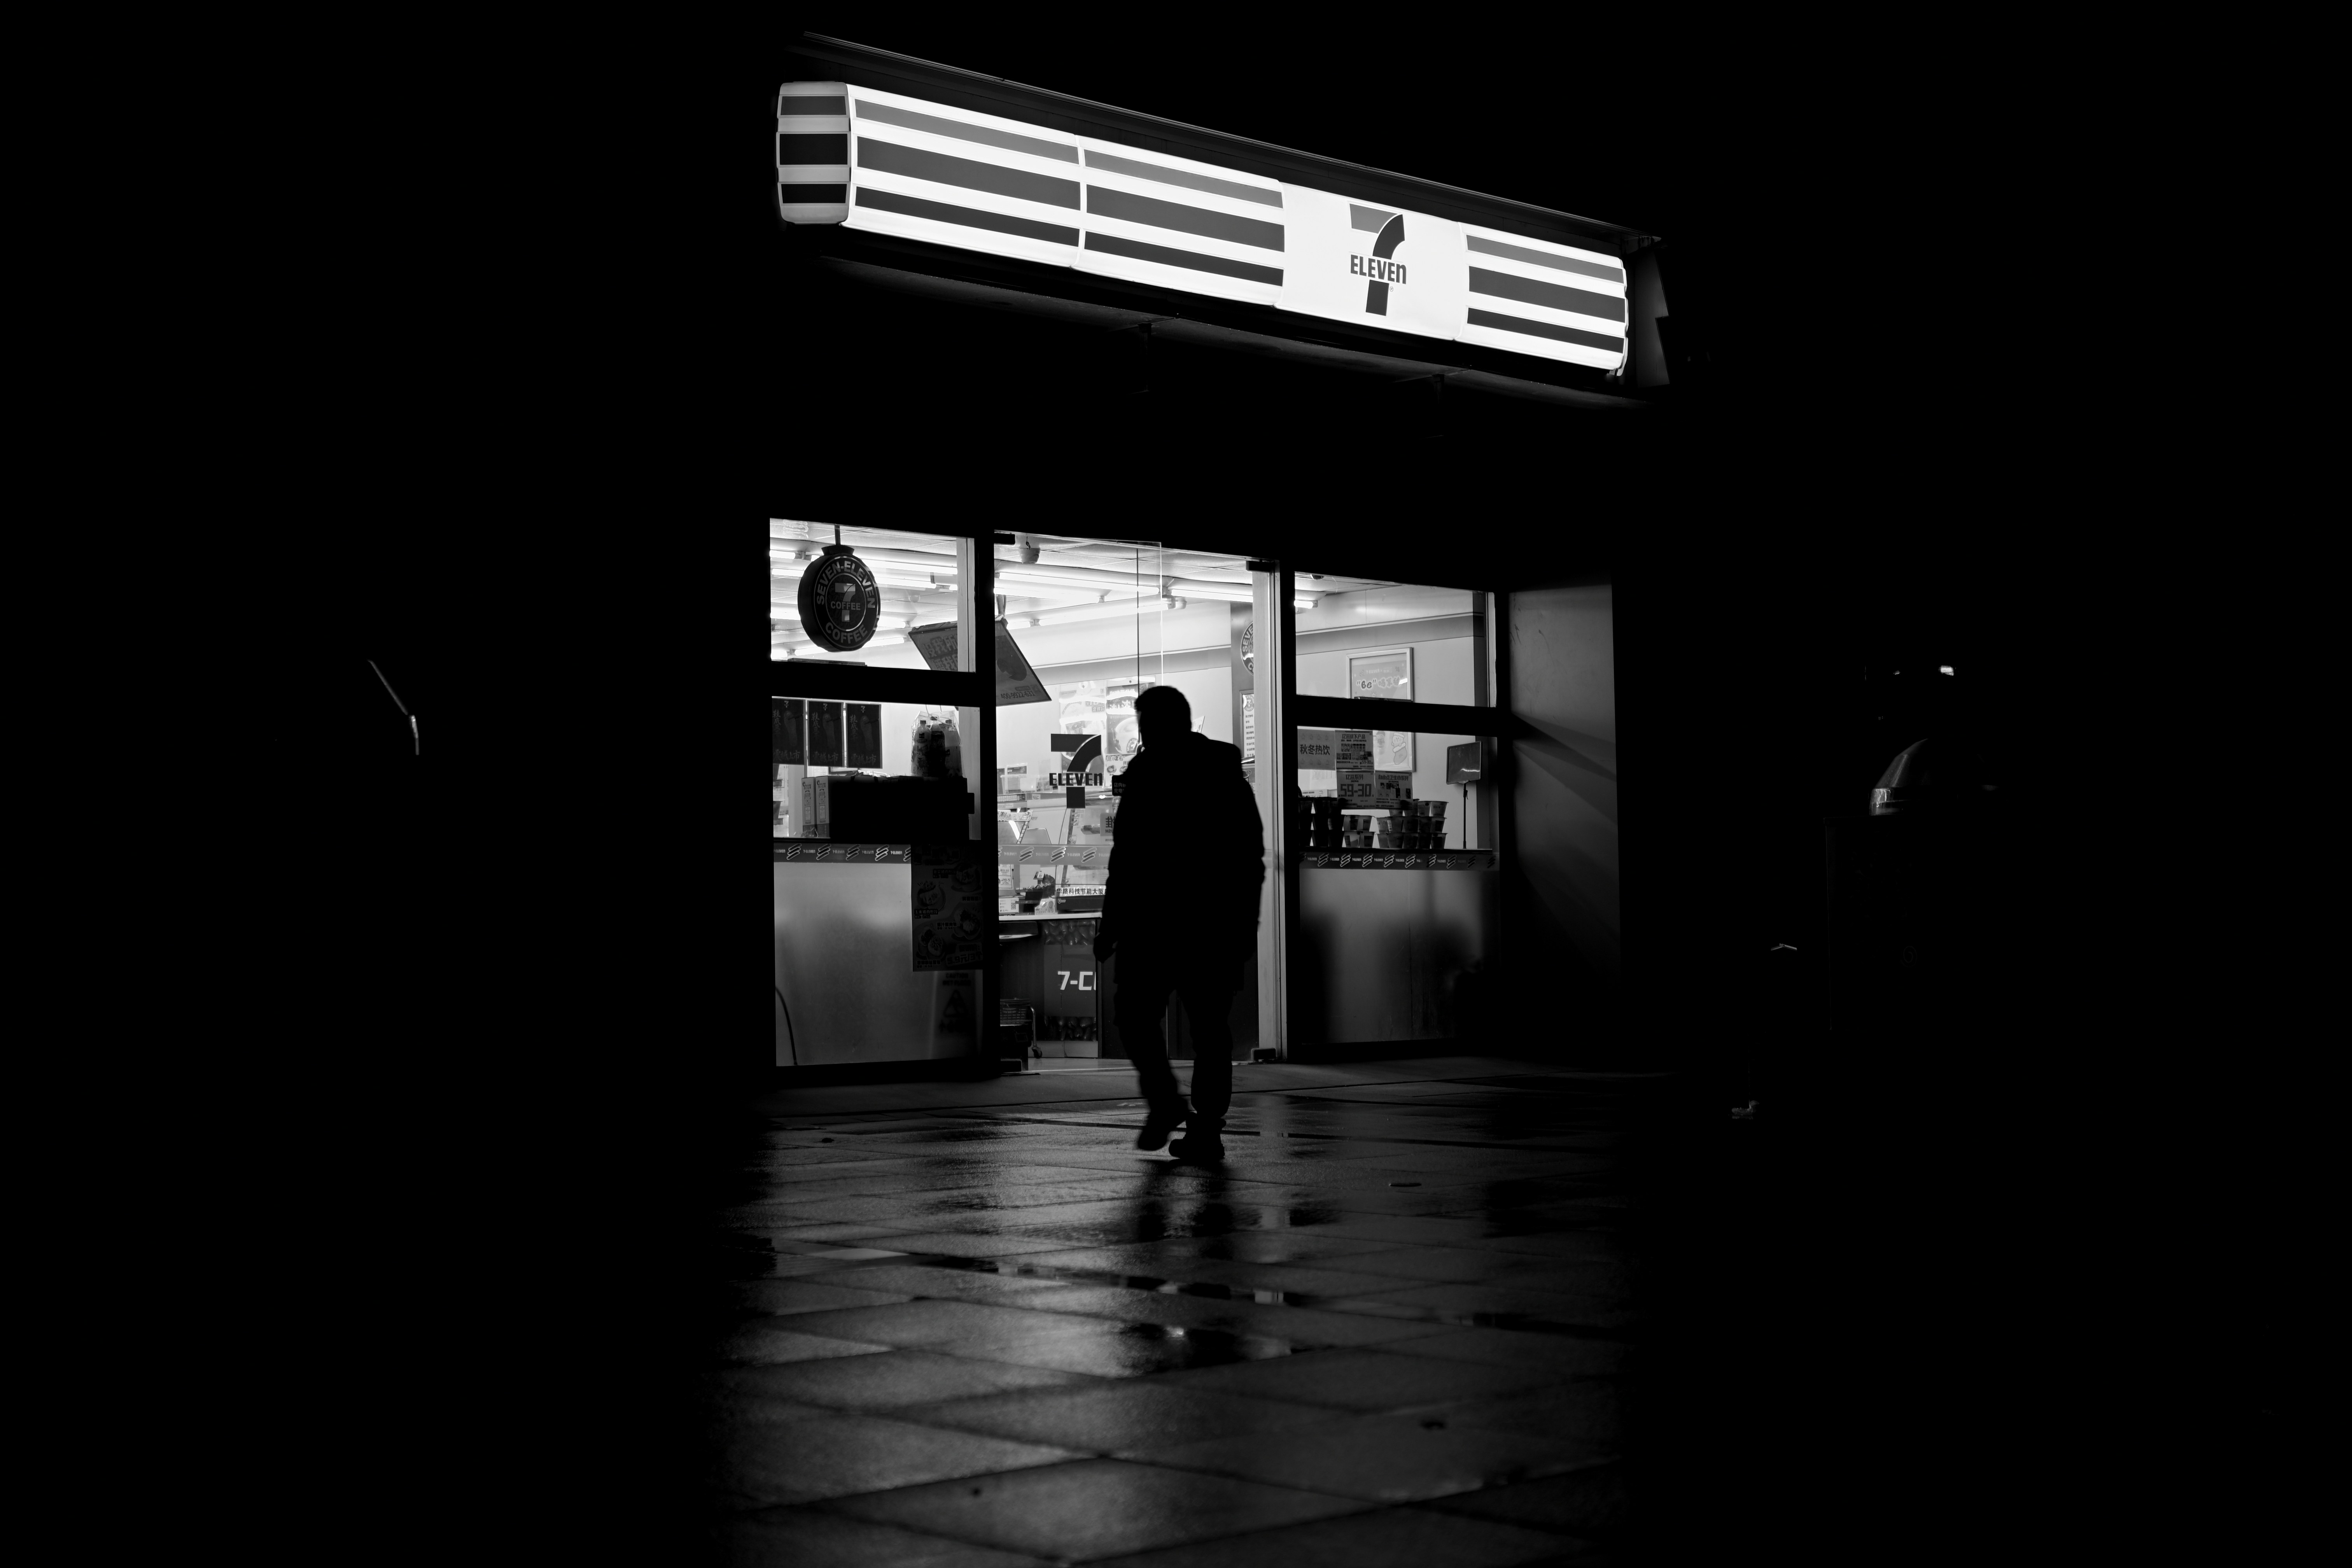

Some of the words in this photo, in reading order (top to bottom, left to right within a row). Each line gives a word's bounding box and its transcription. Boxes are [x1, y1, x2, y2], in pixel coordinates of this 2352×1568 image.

[1349, 203, 1405, 316] 7
[817, 561, 875, 608] SEVEN-ELEVEN
[831, 601, 861, 611] COFFEE
[825, 622, 868, 644] COFFEE
[1001, 691, 1036, 700] 400-9922-631
[1300, 744, 1330, 755] 秋冬热饮
[1050, 733, 1102, 809] 7
[1057, 971, 1096, 991] 7-C
